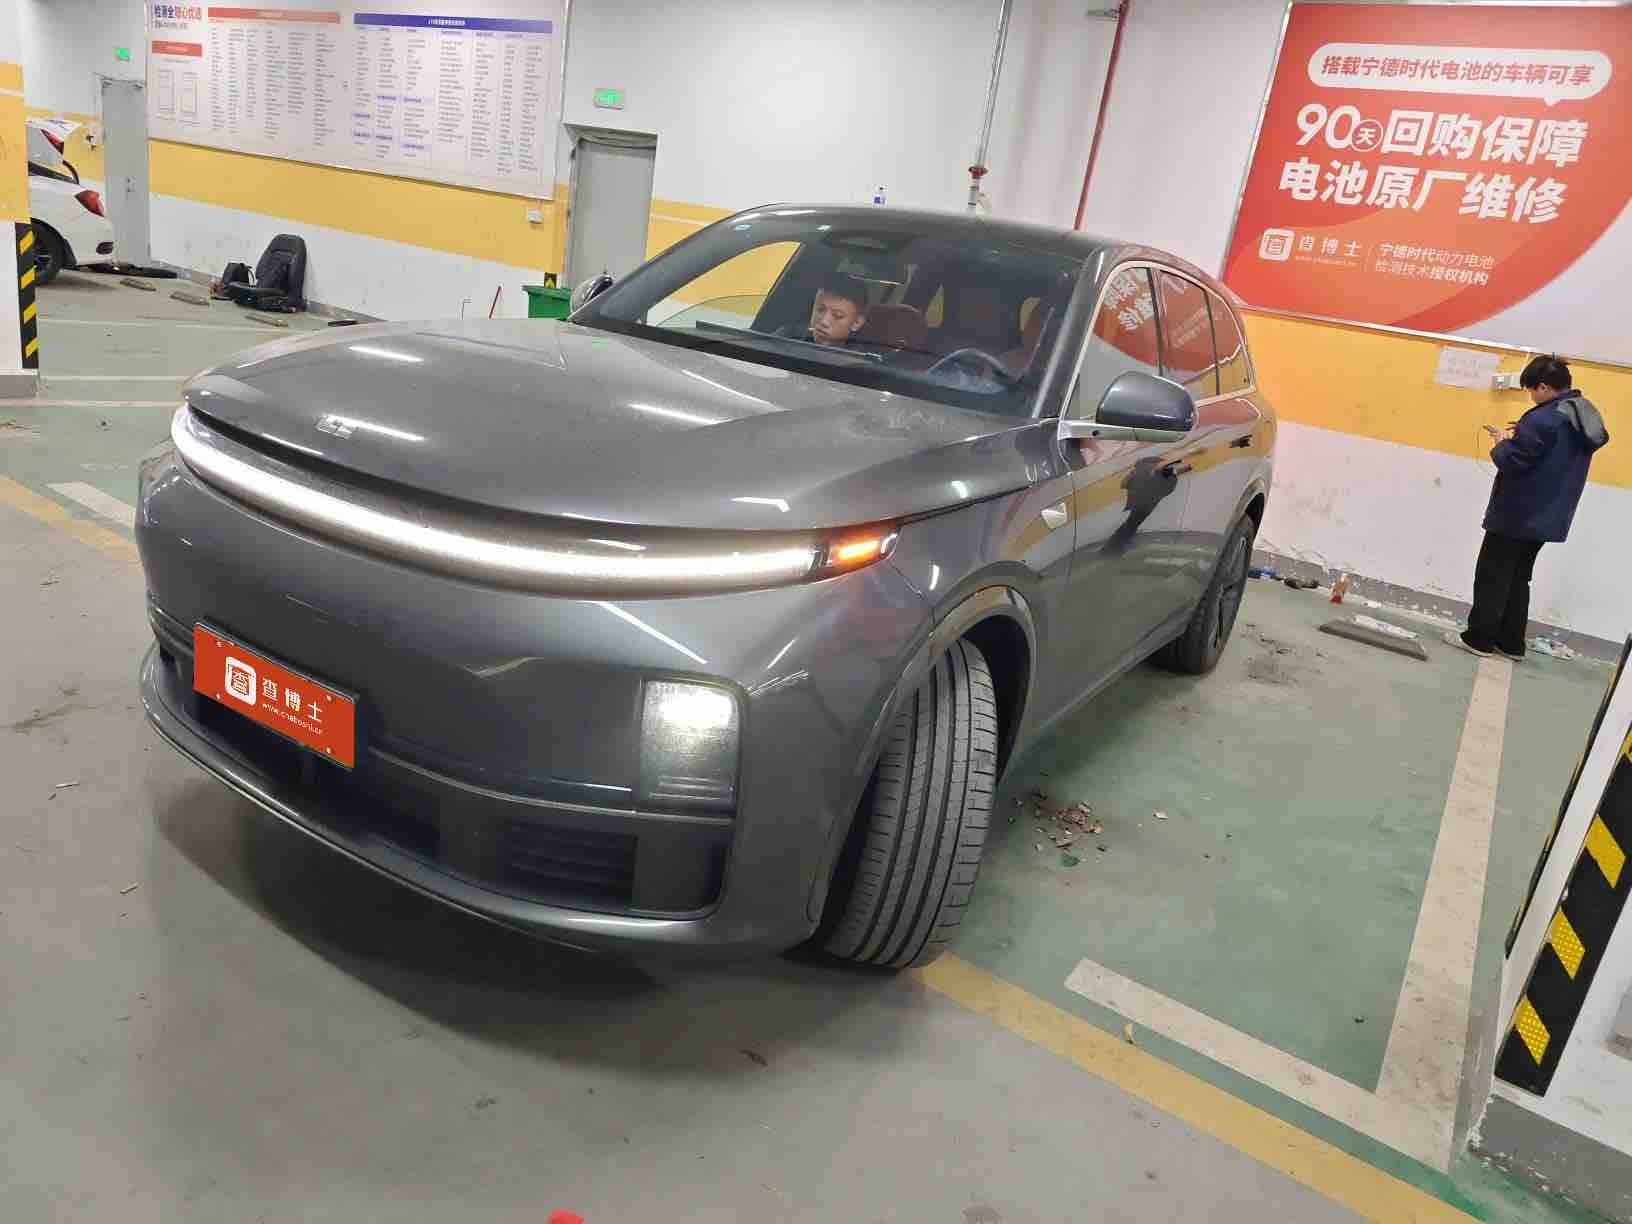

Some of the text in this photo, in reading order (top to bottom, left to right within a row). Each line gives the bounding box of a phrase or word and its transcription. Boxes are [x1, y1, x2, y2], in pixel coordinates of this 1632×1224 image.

[1321, 55, 1594, 86] 搭载宁德时代电池的车辆可享
[1296, 103, 1588, 168] 90天回购保障
[1279, 156, 1568, 223] 电池原厂维修
[1379, 242, 1495, 270] 宁德时代动力电池
[1375, 259, 1488, 287] 检测技术授权机构
